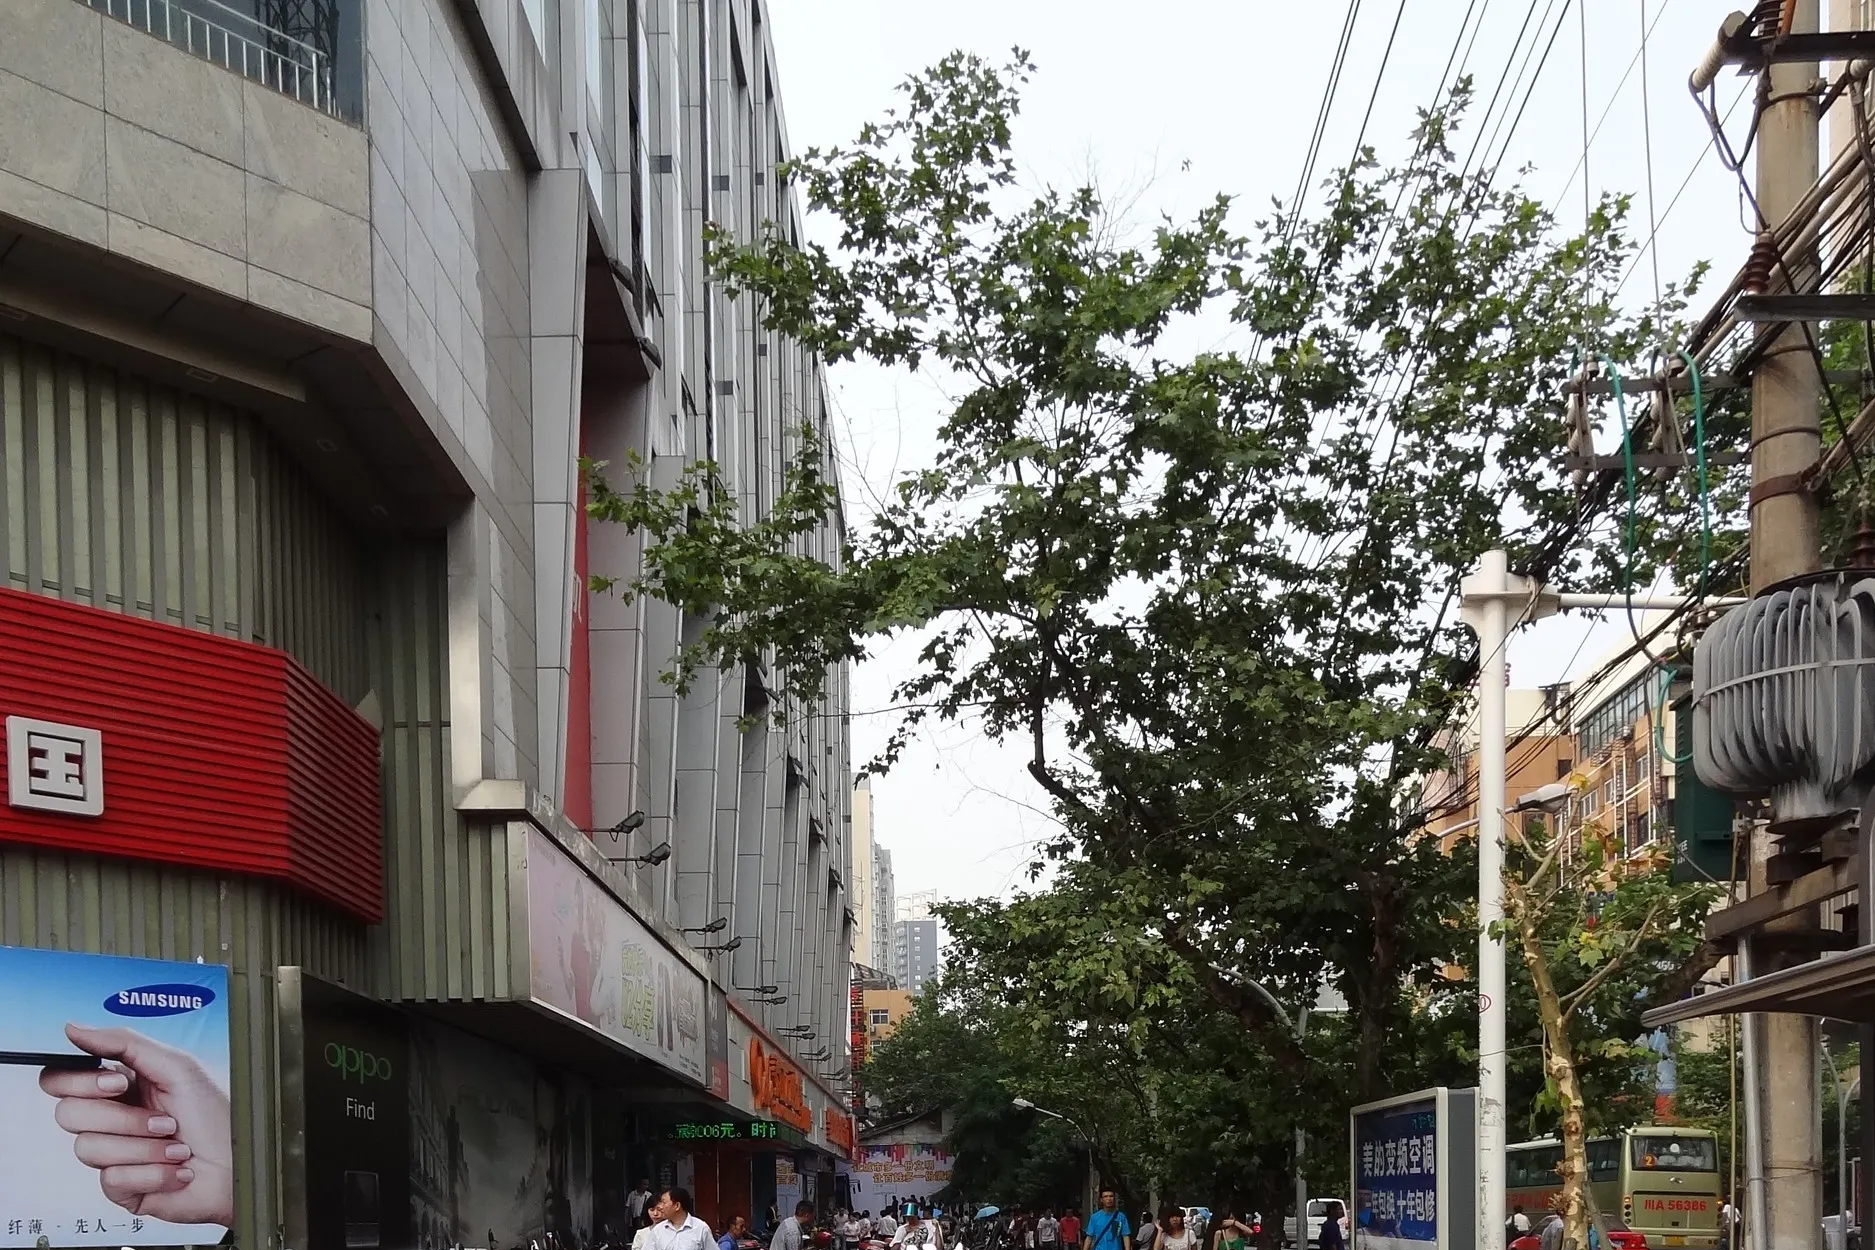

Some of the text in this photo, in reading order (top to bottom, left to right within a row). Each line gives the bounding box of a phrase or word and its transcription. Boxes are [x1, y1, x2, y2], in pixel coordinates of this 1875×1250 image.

[119, 991, 202, 1010] SAMSUNG
[346, 1097, 375, 1120] Find
[1362, 1134, 1435, 1177] 美的变频空调
[1645, 1155, 1653, 1167] 2
[1397, 1188, 1435, 1223] 十年包修
[8, 1219, 43, 1235] 纤薄
[74, 1218, 145, 1234] 先人一步
